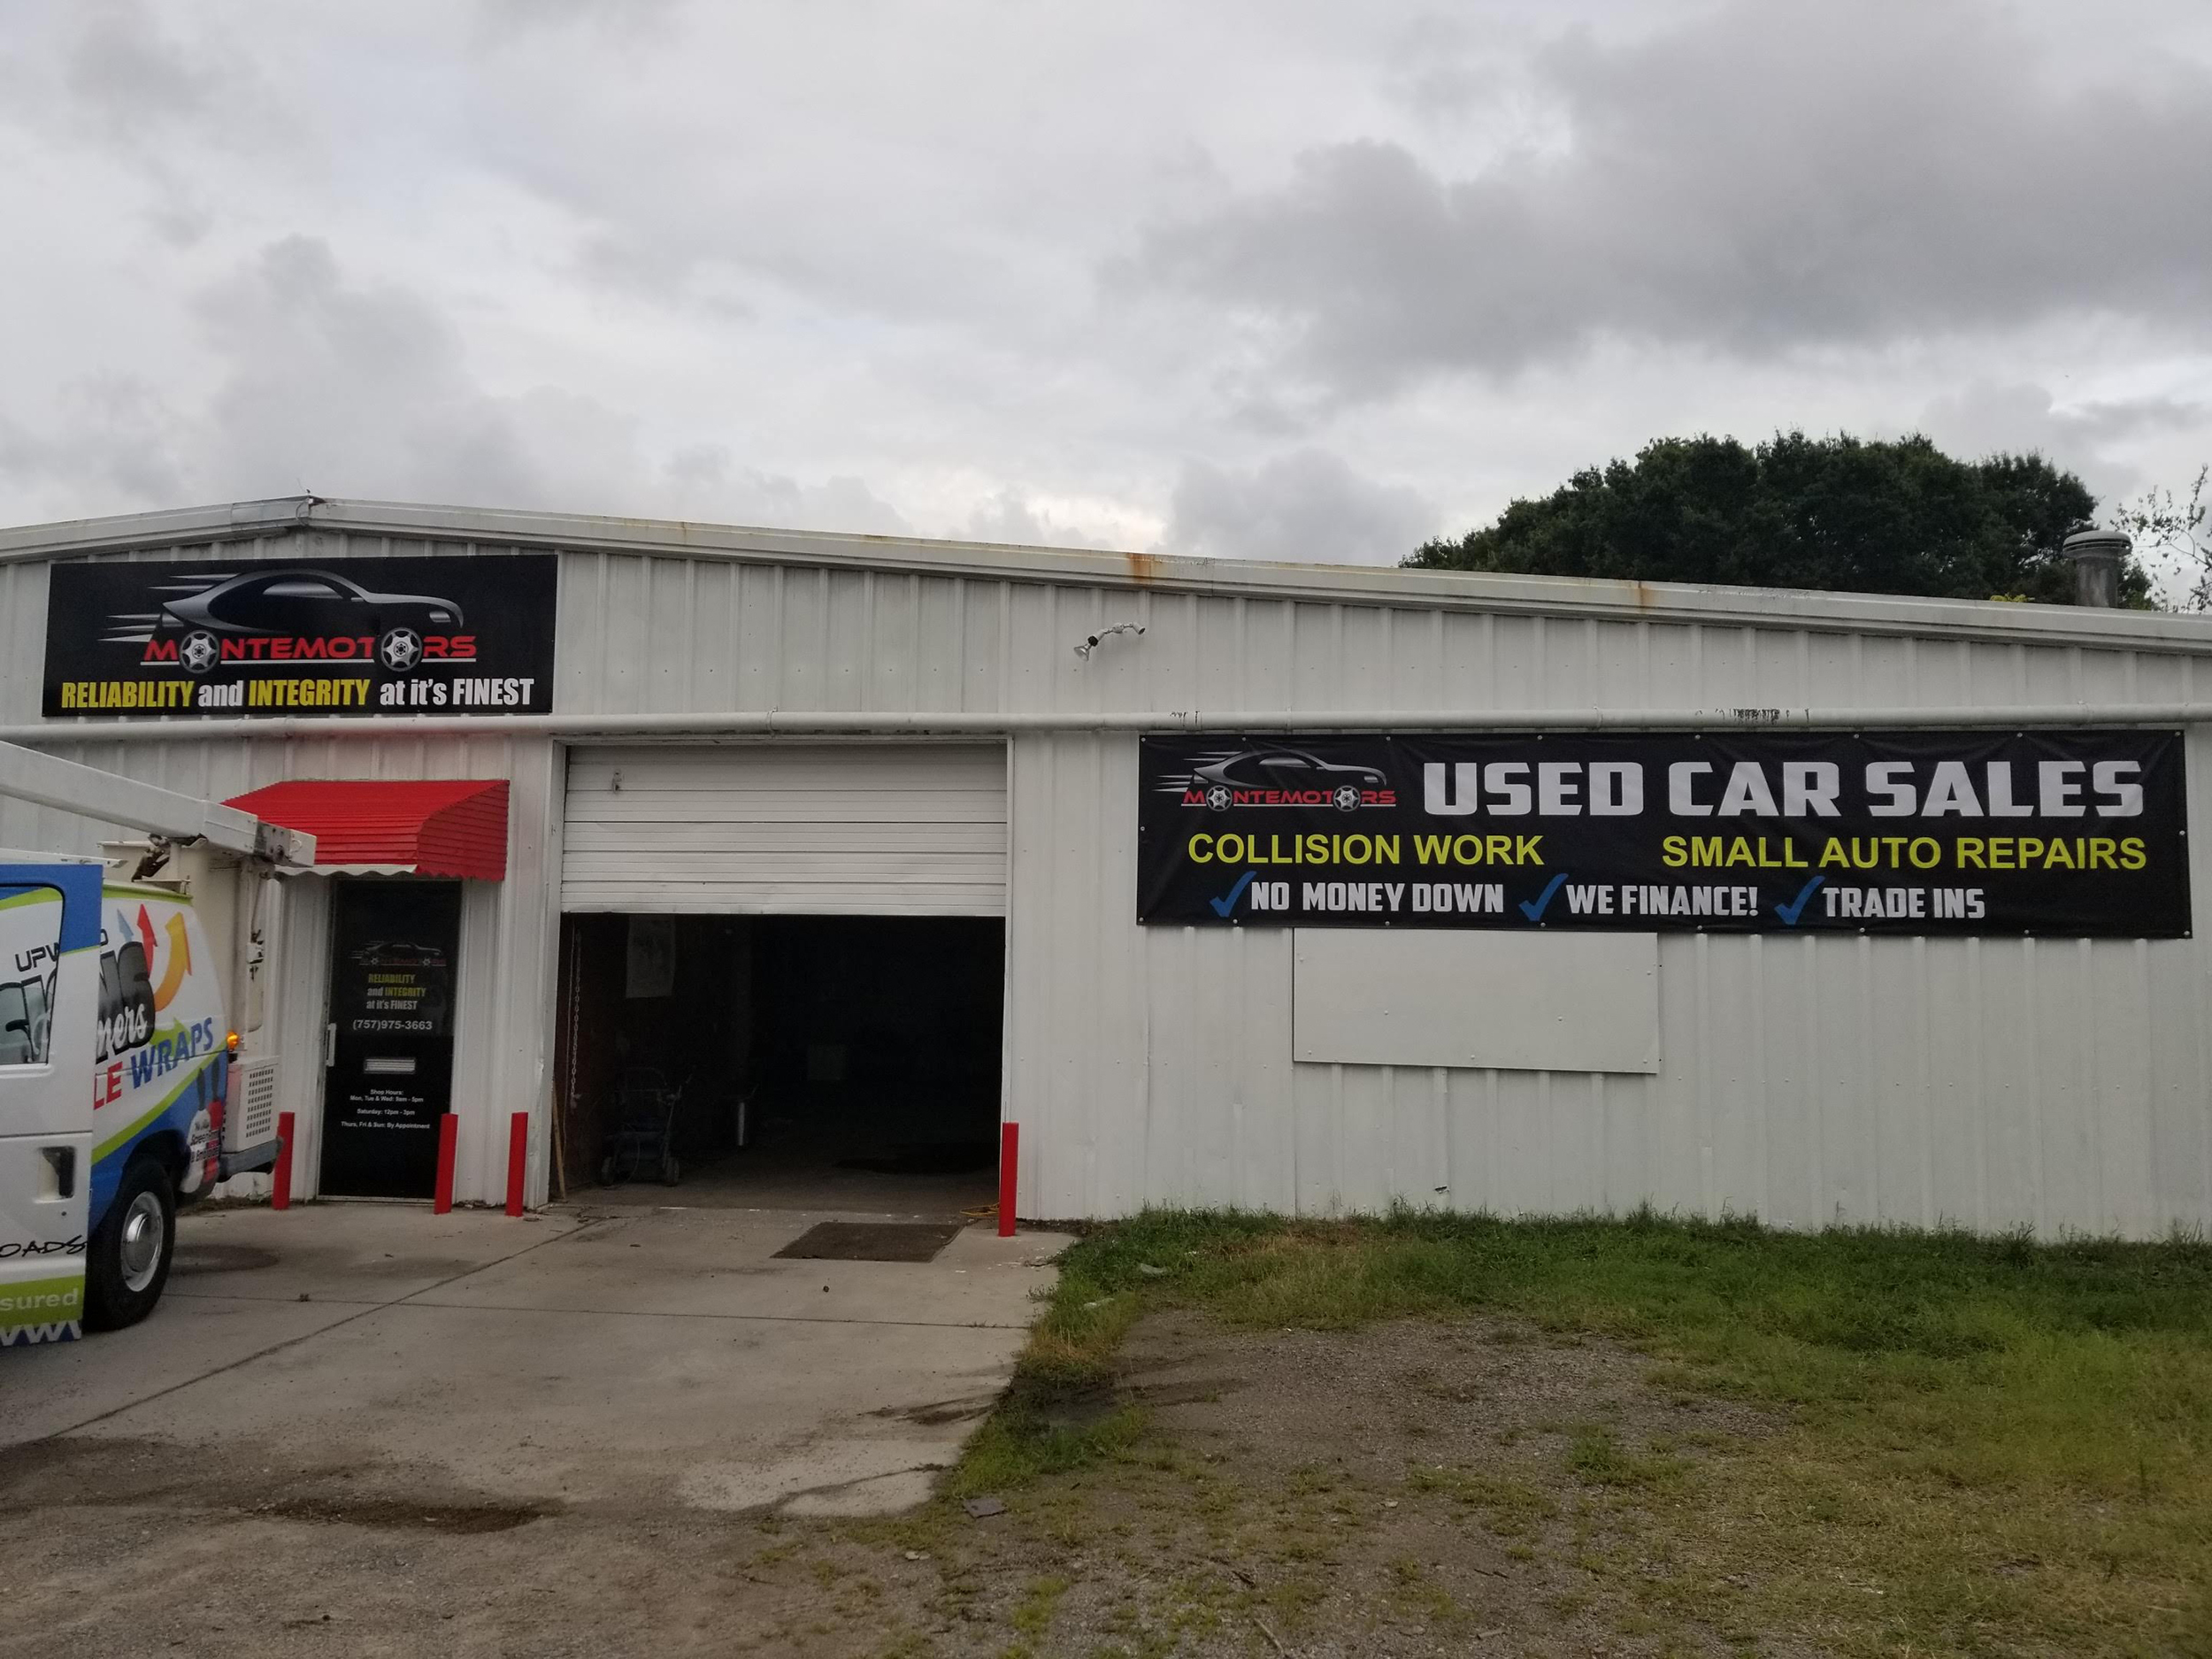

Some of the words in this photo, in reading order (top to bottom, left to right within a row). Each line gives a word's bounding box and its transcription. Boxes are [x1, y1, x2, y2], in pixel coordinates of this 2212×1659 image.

[61, 681, 195, 708] RELIABILITY
[197, 681, 244, 707] and
[249, 679, 370, 706] INTEGRITY
[380, 680, 406, 706] at
[452, 678, 534, 706] FINEST
[1424, 762, 1644, 816] USED
[1668, 761, 1841, 817] CAR
[1865, 761, 2144, 818] SALES
[1187, 833, 1401, 864] COLLISION
[1414, 835, 1545, 865] WORK
[1662, 836, 1808, 867] SMALL
[1819, 837, 1941, 869] AUTO
[1956, 837, 2147, 870] REPAIRS
[1250, 881, 1290, 910] NO
[1302, 882, 1405, 912] MONEY
[1412, 883, 1503, 913] DOWN
[1565, 885, 1613, 914] WE
[1622, 886, 1759, 917] FINANCE!
[1823, 887, 1926, 918] TRADE
[1933, 888, 1985, 918] INS
[367, 987, 384, 997] and
[384, 987, 426, 997] INTEGRITY
[368, 974, 416, 984] RELIABILITY
[365, 1001, 375, 1010] at
[390, 1001, 419, 1010] FINEST
[353, 1019, 434, 1032] (757)975-3663
[130, 1017, 214, 1090] WRAPS
